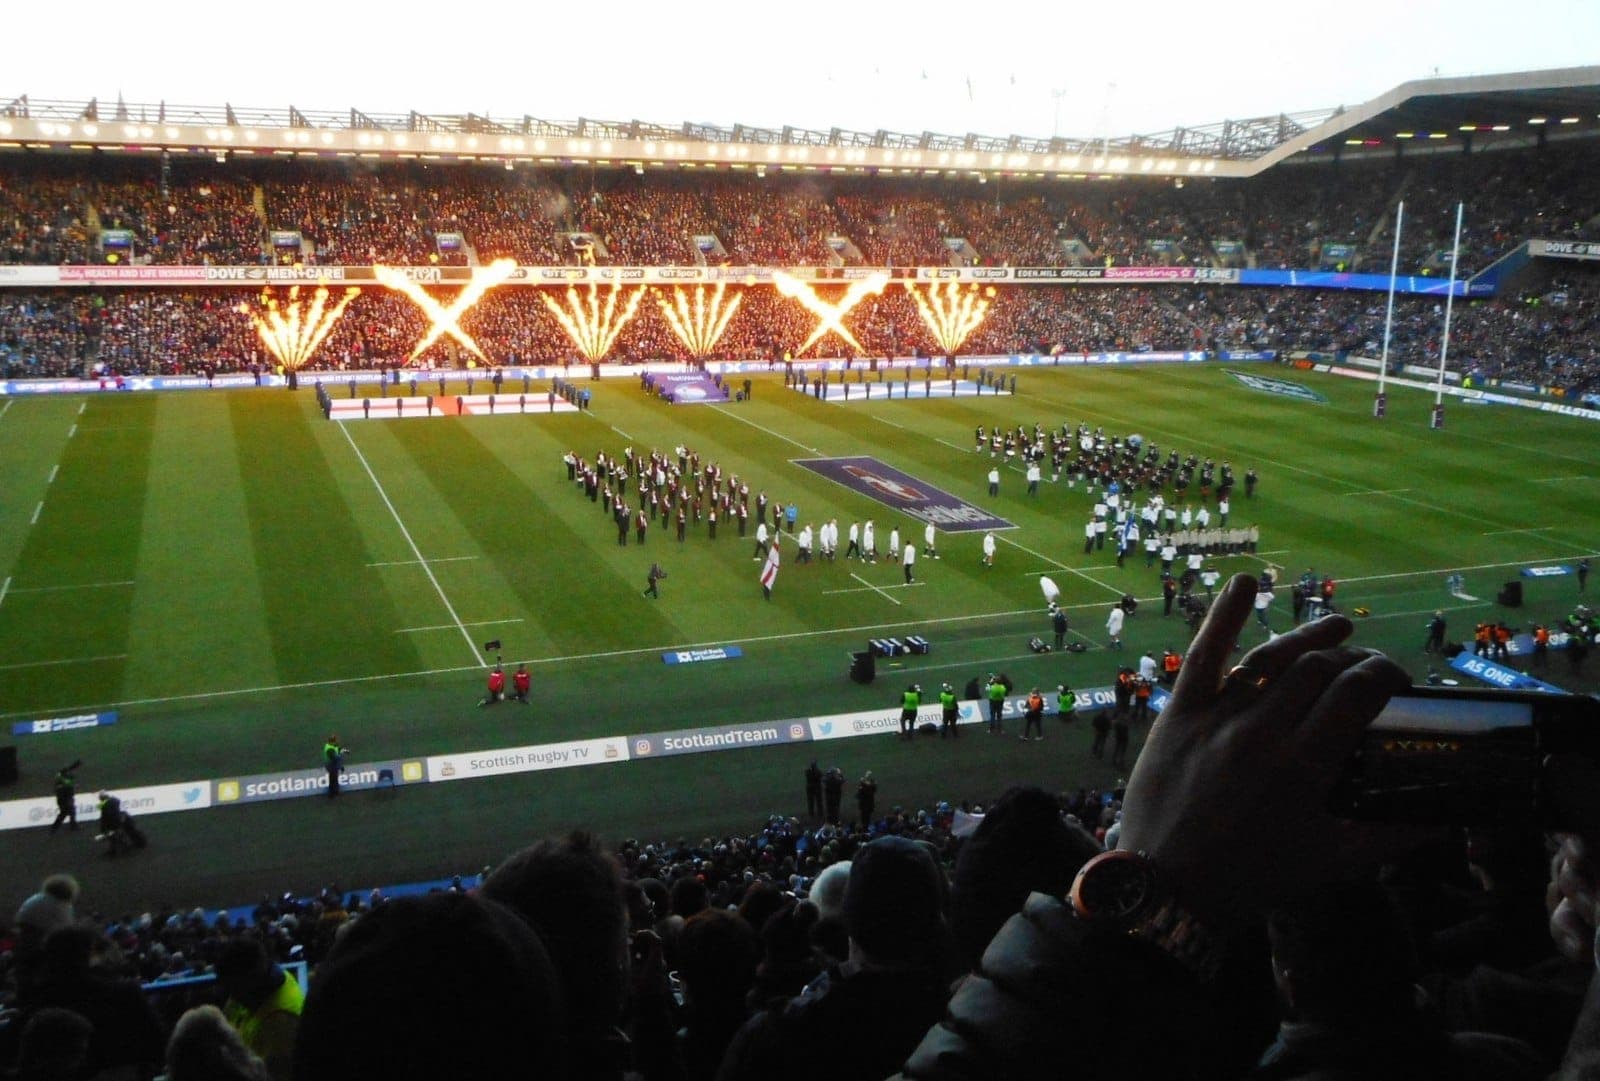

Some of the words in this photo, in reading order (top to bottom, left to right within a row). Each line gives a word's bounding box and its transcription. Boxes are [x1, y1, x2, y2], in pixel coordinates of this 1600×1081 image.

[1545, 242, 1573, 253] DOVE
[85, 268, 118, 279] HEALTH
[119, 268, 138, 279] AND
[140, 268, 157, 279] LIFE
[207, 268, 246, 279] DOVE
[1105, 268, 1180, 279] Superdrug
[1462, 660, 1482, 674] AS
[1483, 667, 1517, 686] ONE
[1074, 692, 1093, 706] AS
[663, 728, 778, 751] ScotlandTeam
[470, 754, 525, 771] Scottish
[528, 749, 569, 765] Rugby
[572, 747, 589, 759] TV
[245, 769, 379, 798] scotlandeam
